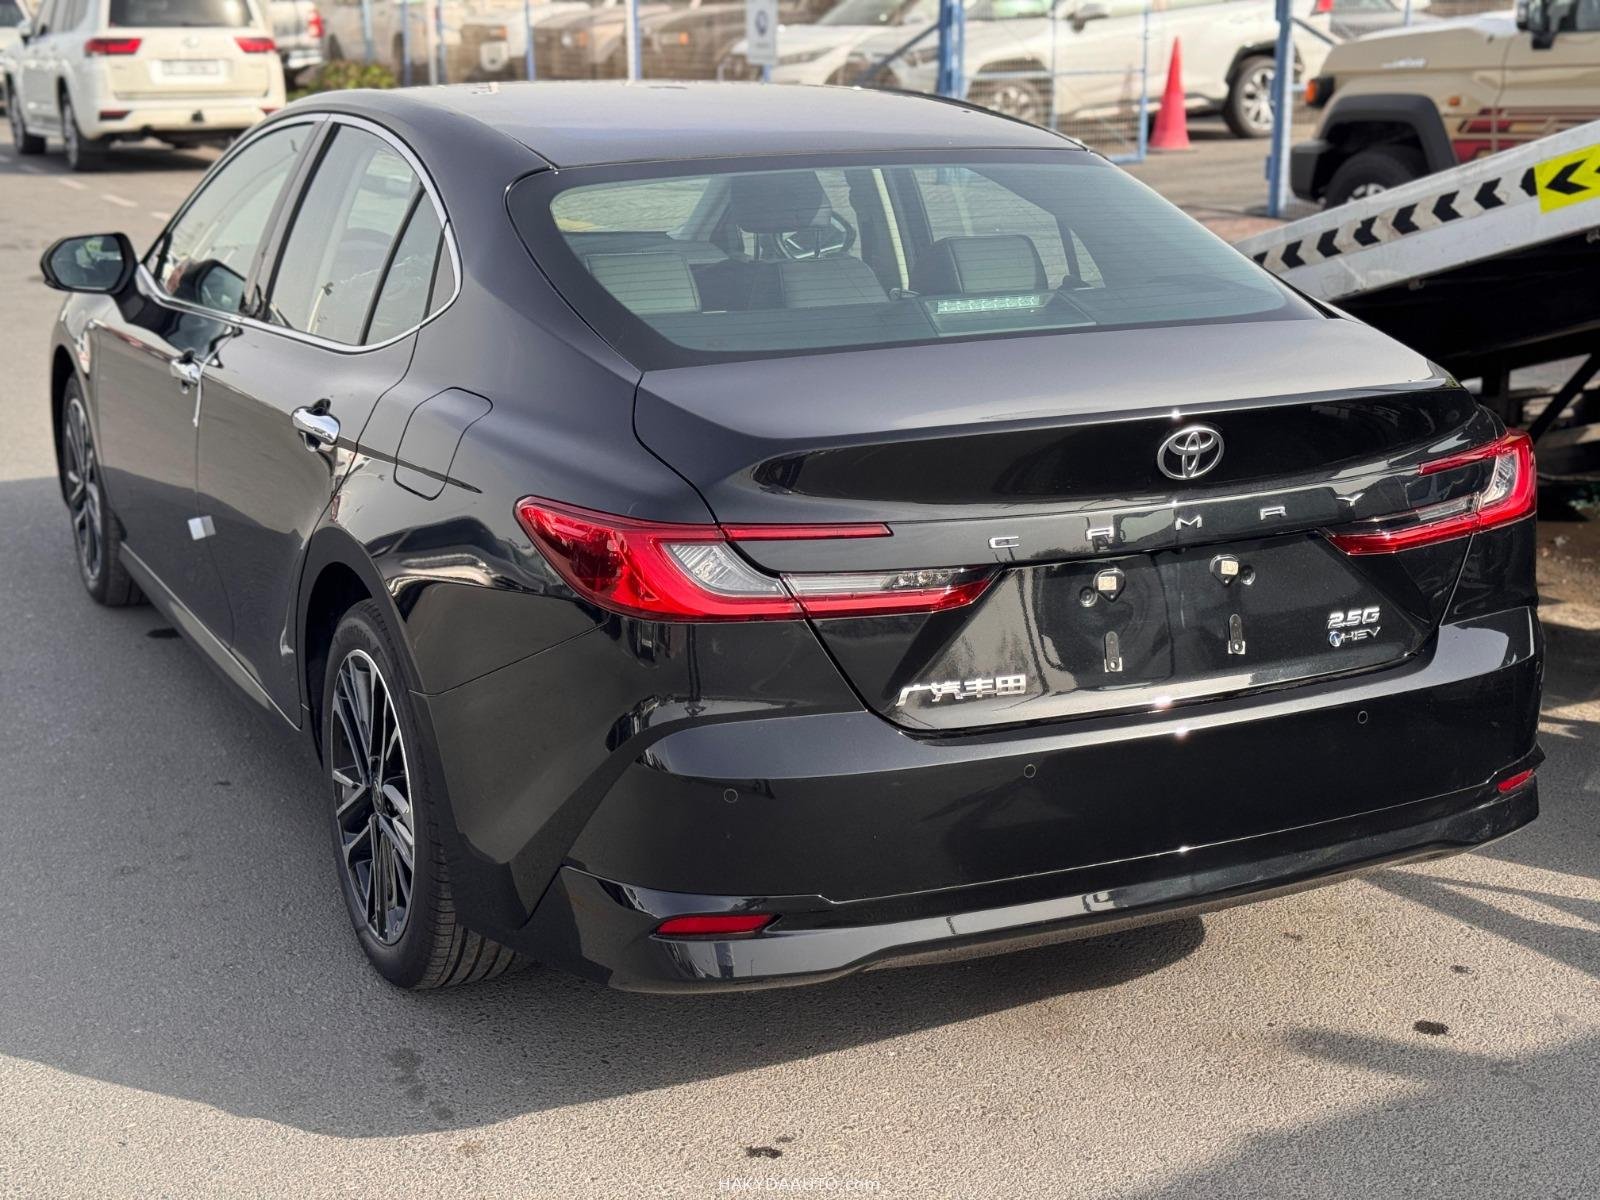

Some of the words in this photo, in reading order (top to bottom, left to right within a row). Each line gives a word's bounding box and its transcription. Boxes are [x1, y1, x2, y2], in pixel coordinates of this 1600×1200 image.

[989, 492, 1364, 549] CAMRY
[1340, 626, 1381, 643] HEV
[896, 674, 1027, 707] 广汽丰田
